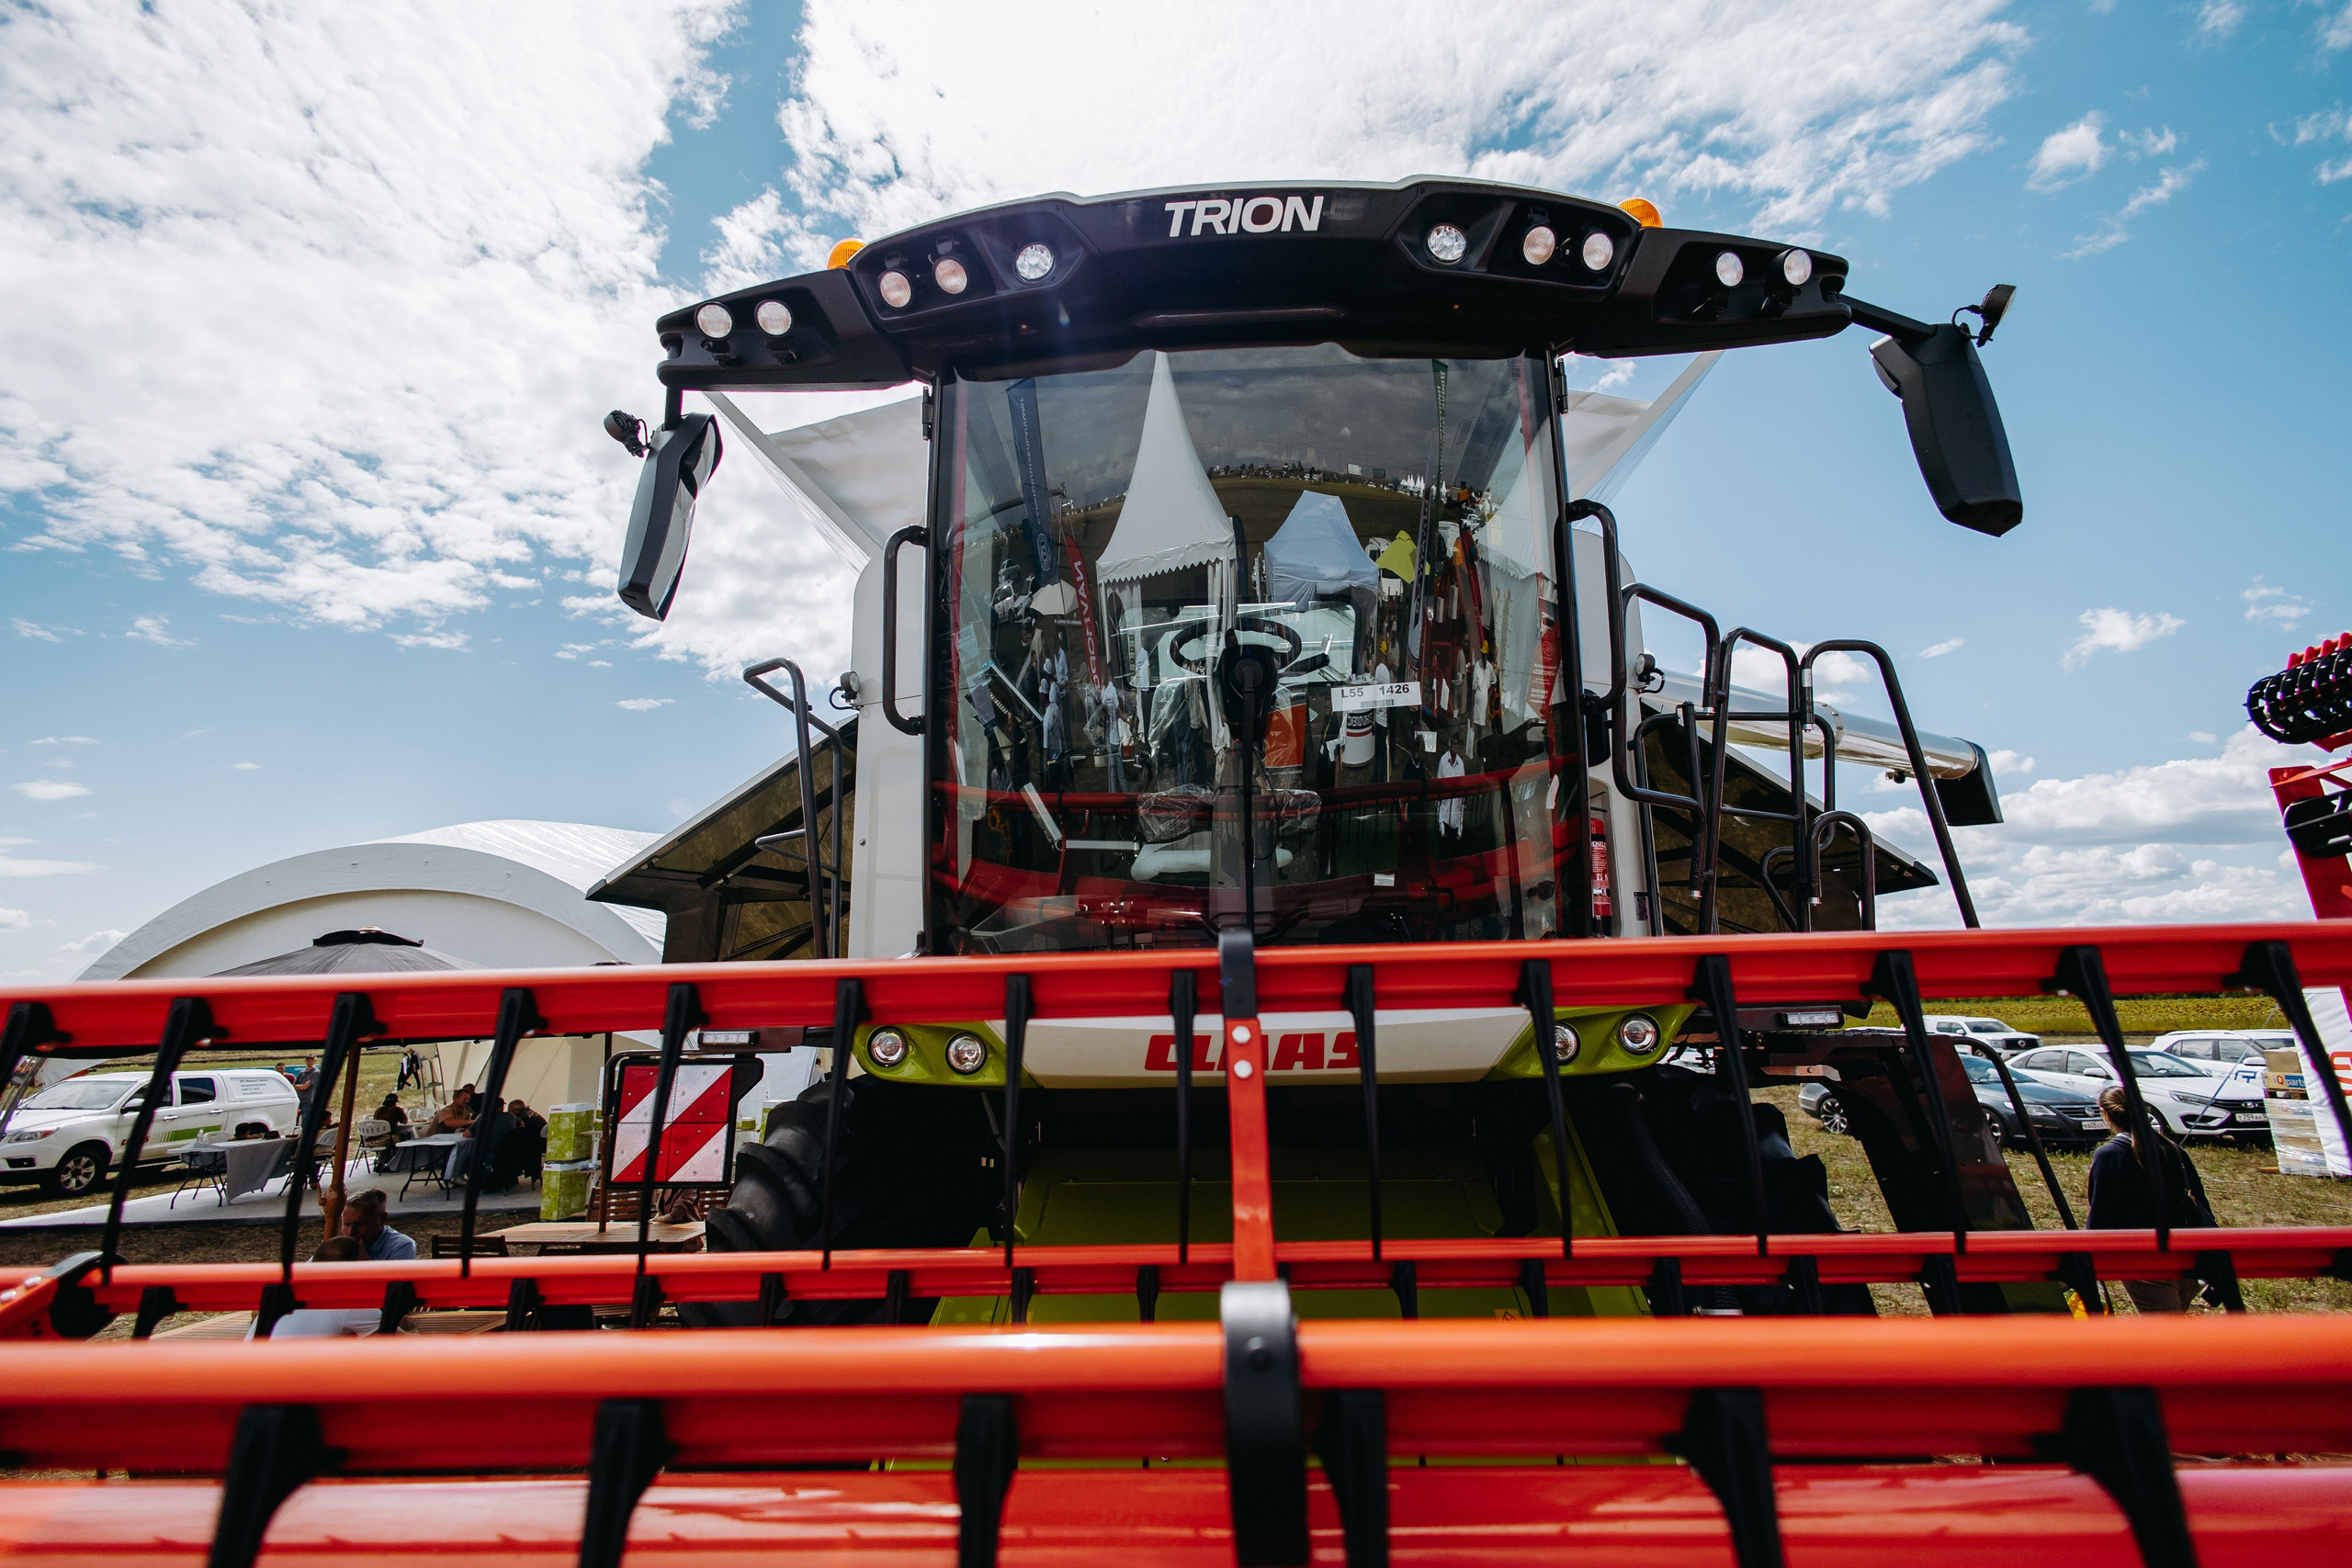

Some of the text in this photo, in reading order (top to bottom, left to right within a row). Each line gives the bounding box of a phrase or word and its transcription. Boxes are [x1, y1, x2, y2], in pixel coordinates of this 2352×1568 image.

[1164, 196, 1324, 238] TRION
[1341, 684, 1409, 699] L55 1426
[2273, 1075, 2305, 1088] iQ parts
